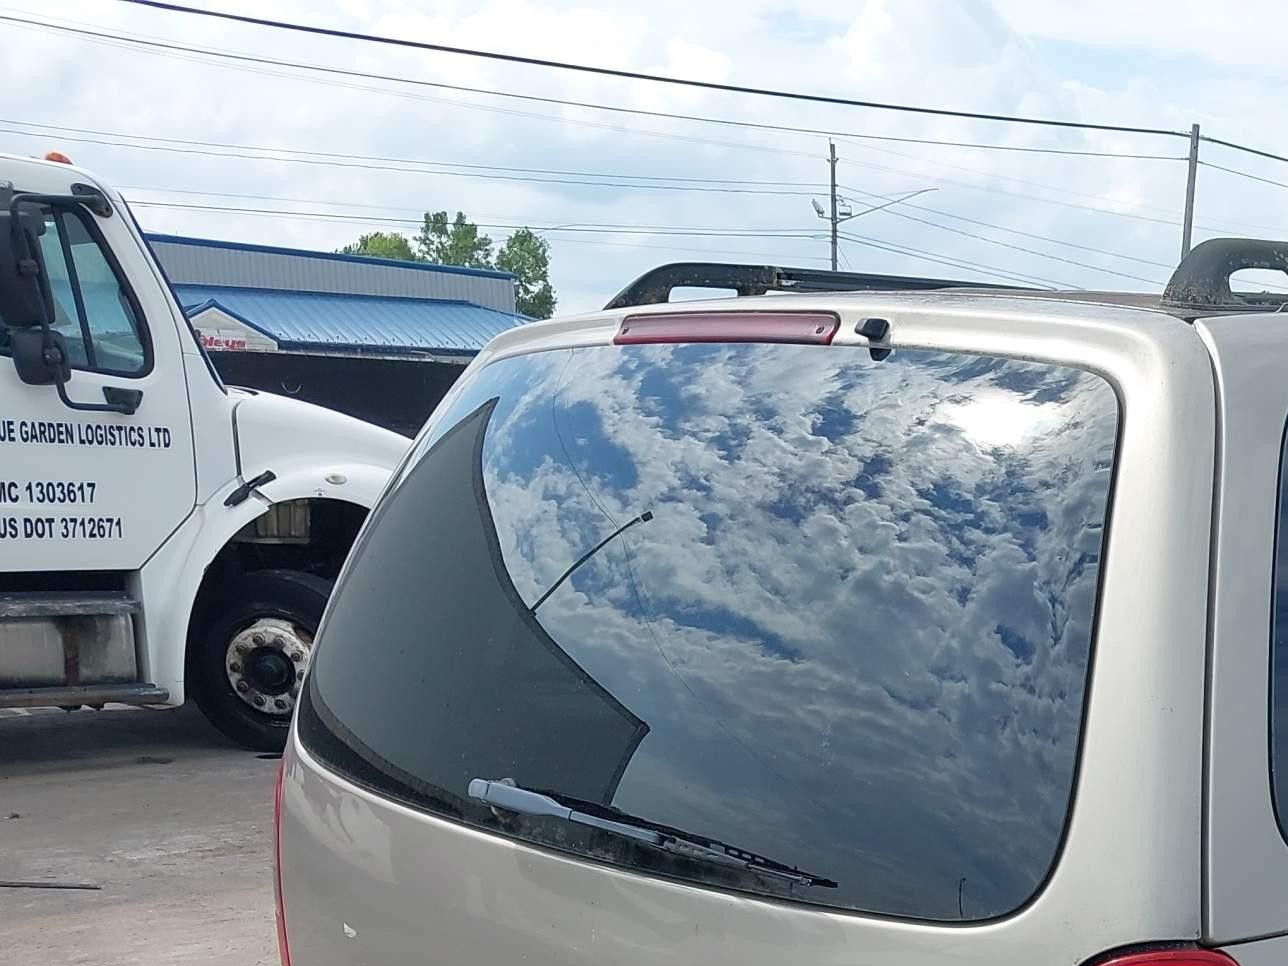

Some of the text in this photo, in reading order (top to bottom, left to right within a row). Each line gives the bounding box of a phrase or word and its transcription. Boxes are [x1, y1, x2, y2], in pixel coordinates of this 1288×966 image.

[20, 421, 75, 445] GARDEN
[78, 423, 145, 448] LOGISTICS
[148, 427, 172, 448] LTD
[25, 482, 96, 504] 1303617
[23, 518, 55, 539] DOT
[60, 518, 122, 539] 3712671
